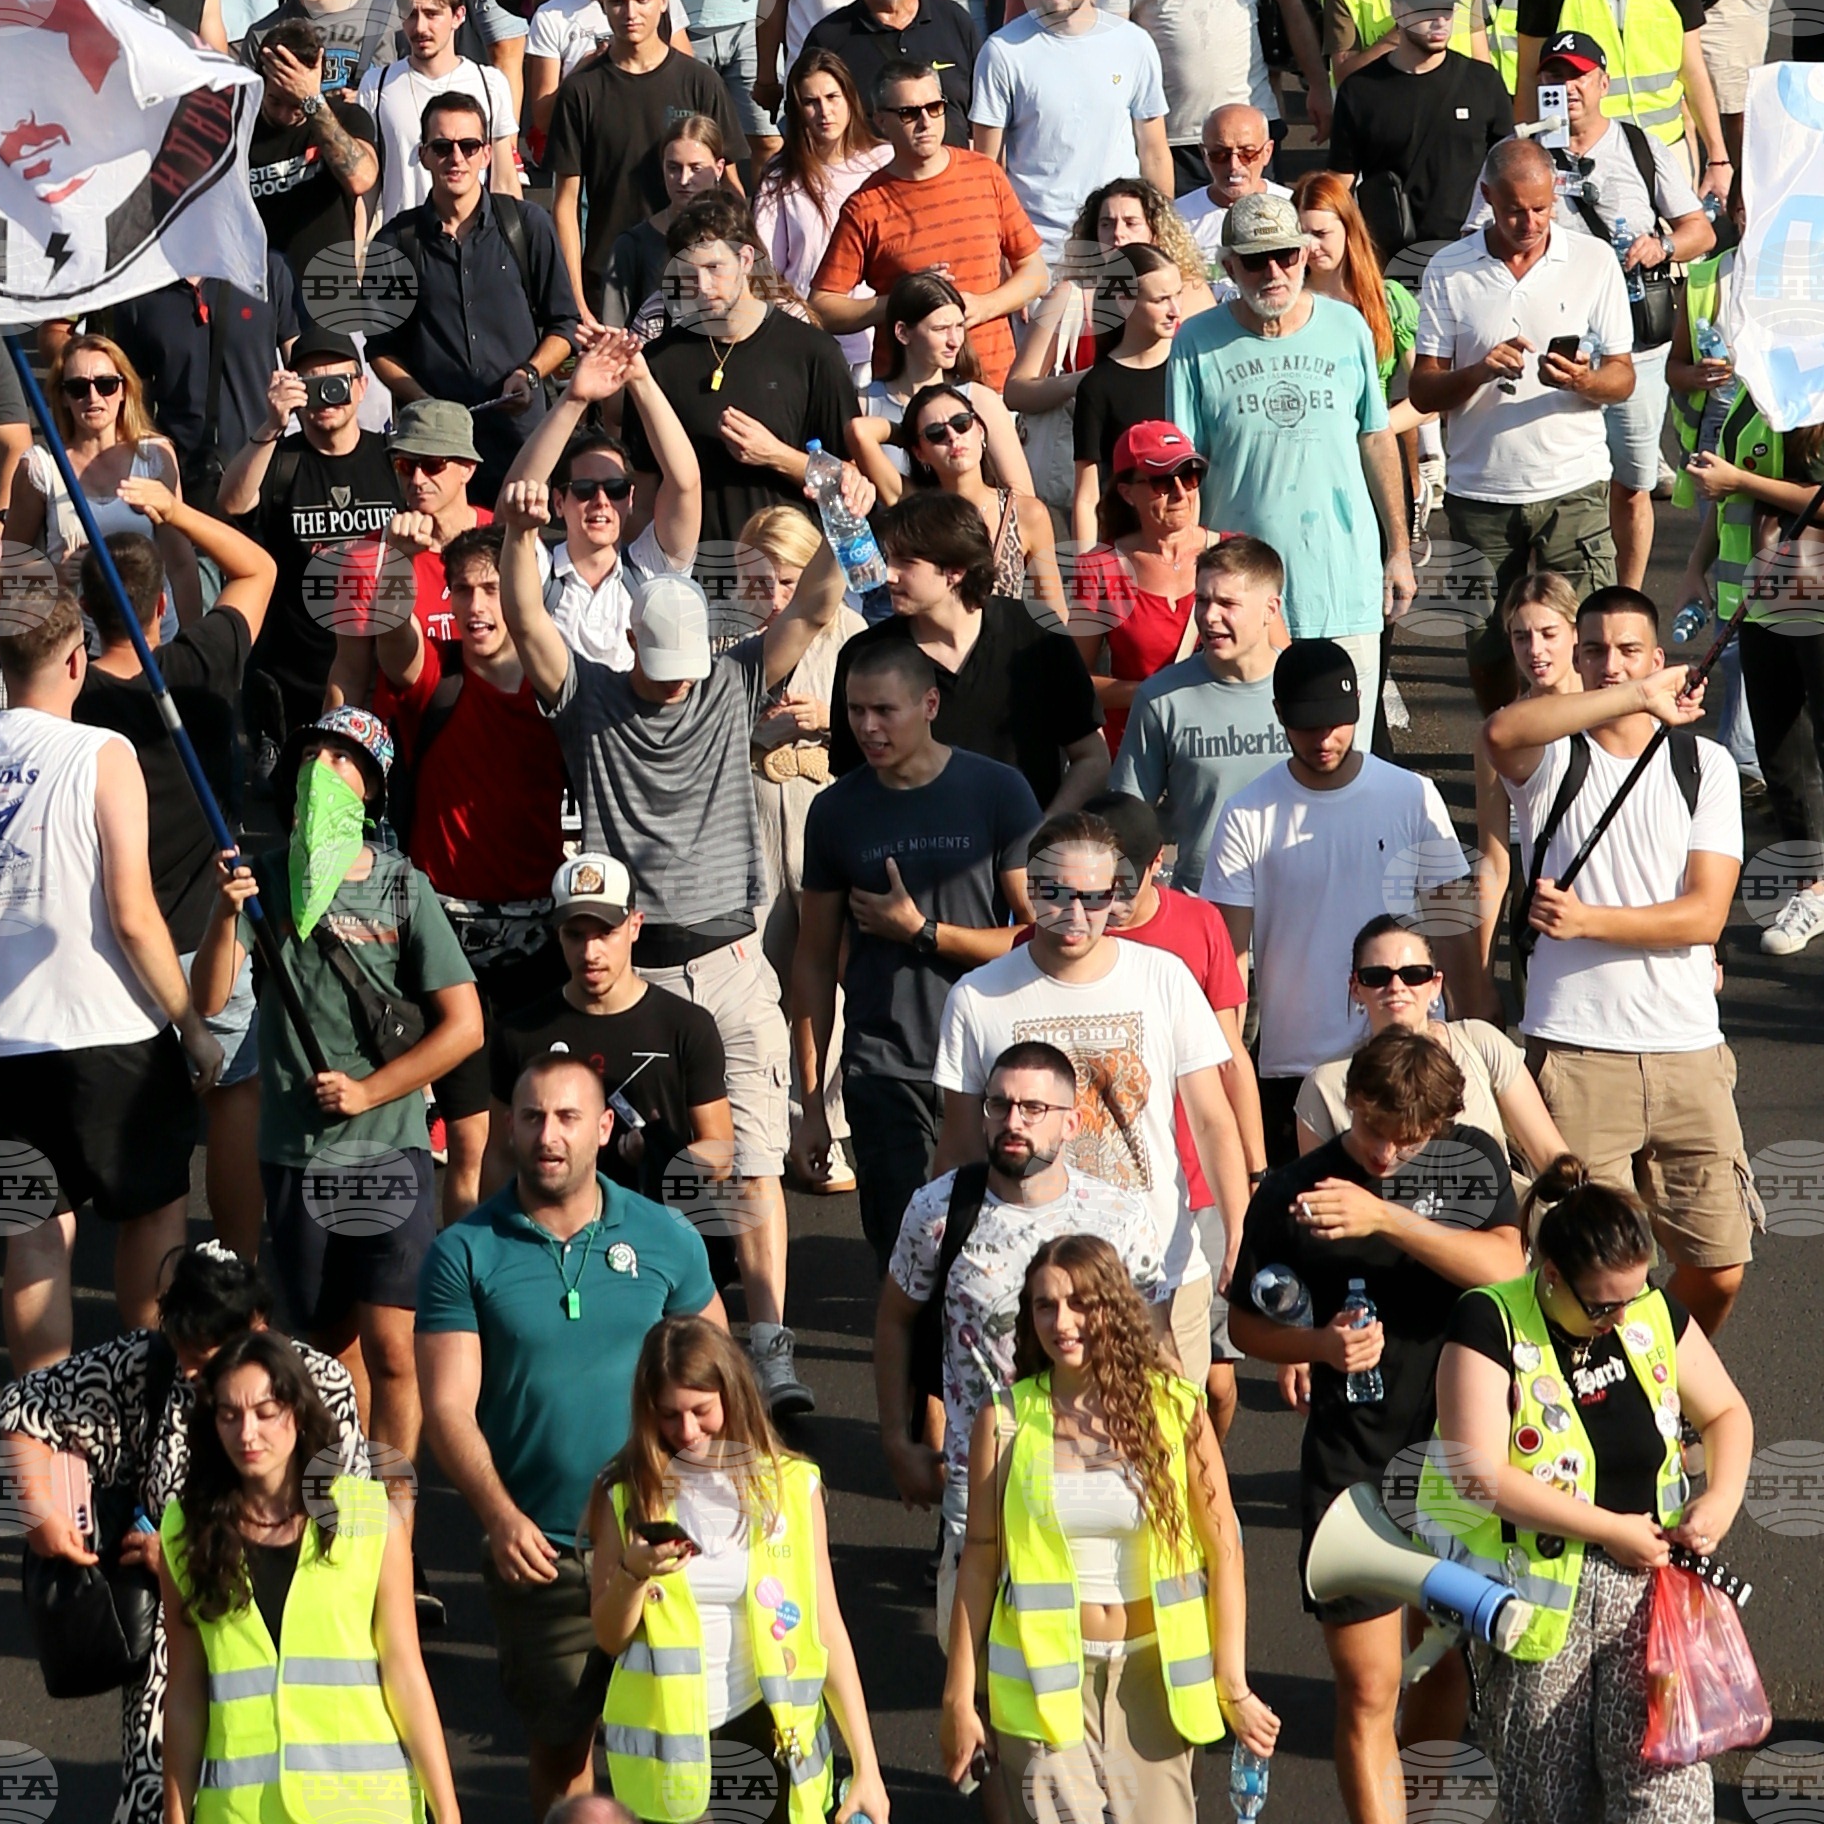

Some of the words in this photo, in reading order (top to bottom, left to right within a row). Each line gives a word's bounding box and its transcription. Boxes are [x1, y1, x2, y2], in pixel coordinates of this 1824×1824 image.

[1225, 360, 1263, 385] TOM
[1272, 355, 1336, 378] TAILOR
[1236, 394, 1260, 417] 19
[1309, 388, 1337, 410] 62
[291, 511, 326, 538] THE
[1184, 724, 1294, 759] Timberla
[862, 842, 908, 863] SIMPLE
[910, 835, 972, 853] MOMENTS
[1032, 1025, 1131, 1044] NIGERIA
